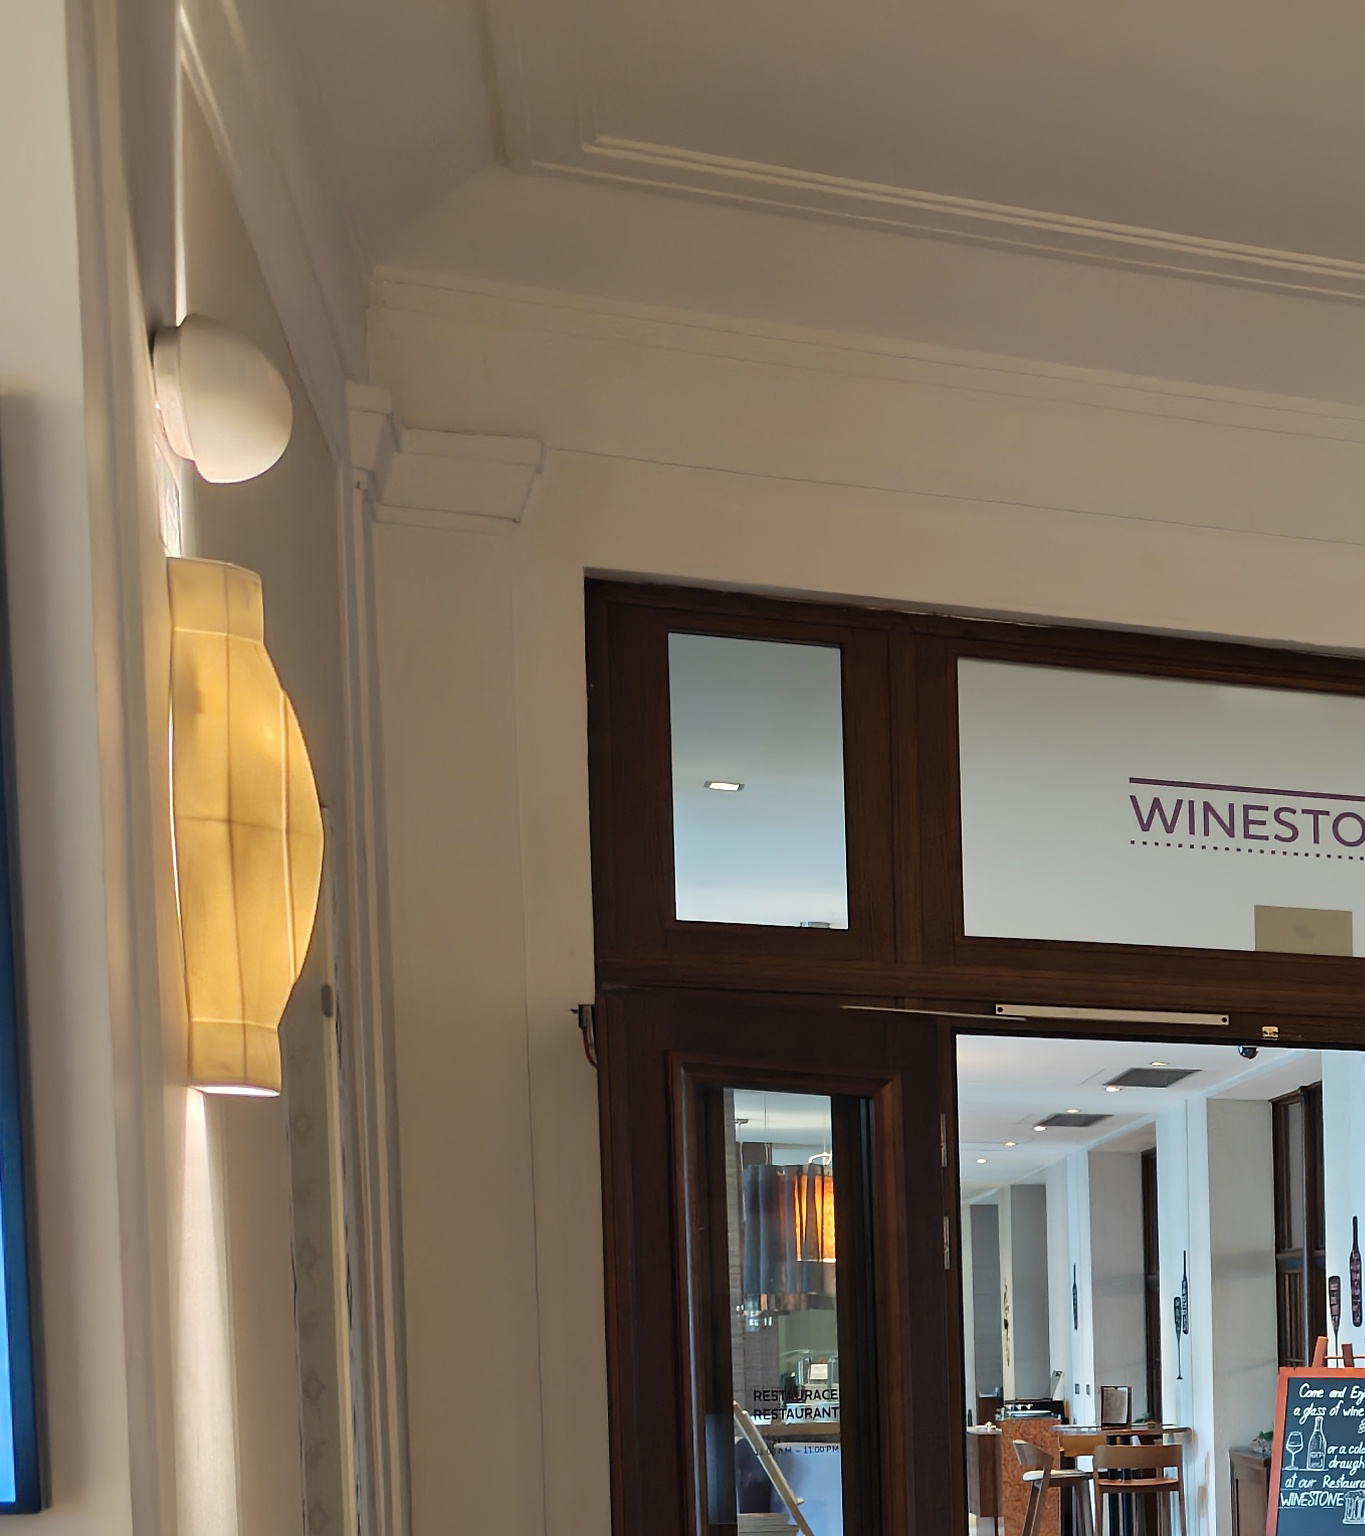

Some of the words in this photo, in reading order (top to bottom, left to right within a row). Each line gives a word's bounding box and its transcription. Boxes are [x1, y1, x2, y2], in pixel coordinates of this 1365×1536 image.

[1299, 1382, 1324, 1399] Come
[1329, 1386, 1346, 1398] and
[754, 1406, 840, 1421] RESTAURANT
[1293, 1407, 1301, 1416] a
[1299, 1403, 1327, 1424] glass
[1329, 1400, 1344, 1416] of
[1343, 1405, 1365, 1417] wine
[1339, 1445, 1347, 1454] a
[1285, 1475, 1298, 1489] at
[1299, 1478, 1317, 1488] our
[1280, 1490, 1345, 1507] WINESTONE
